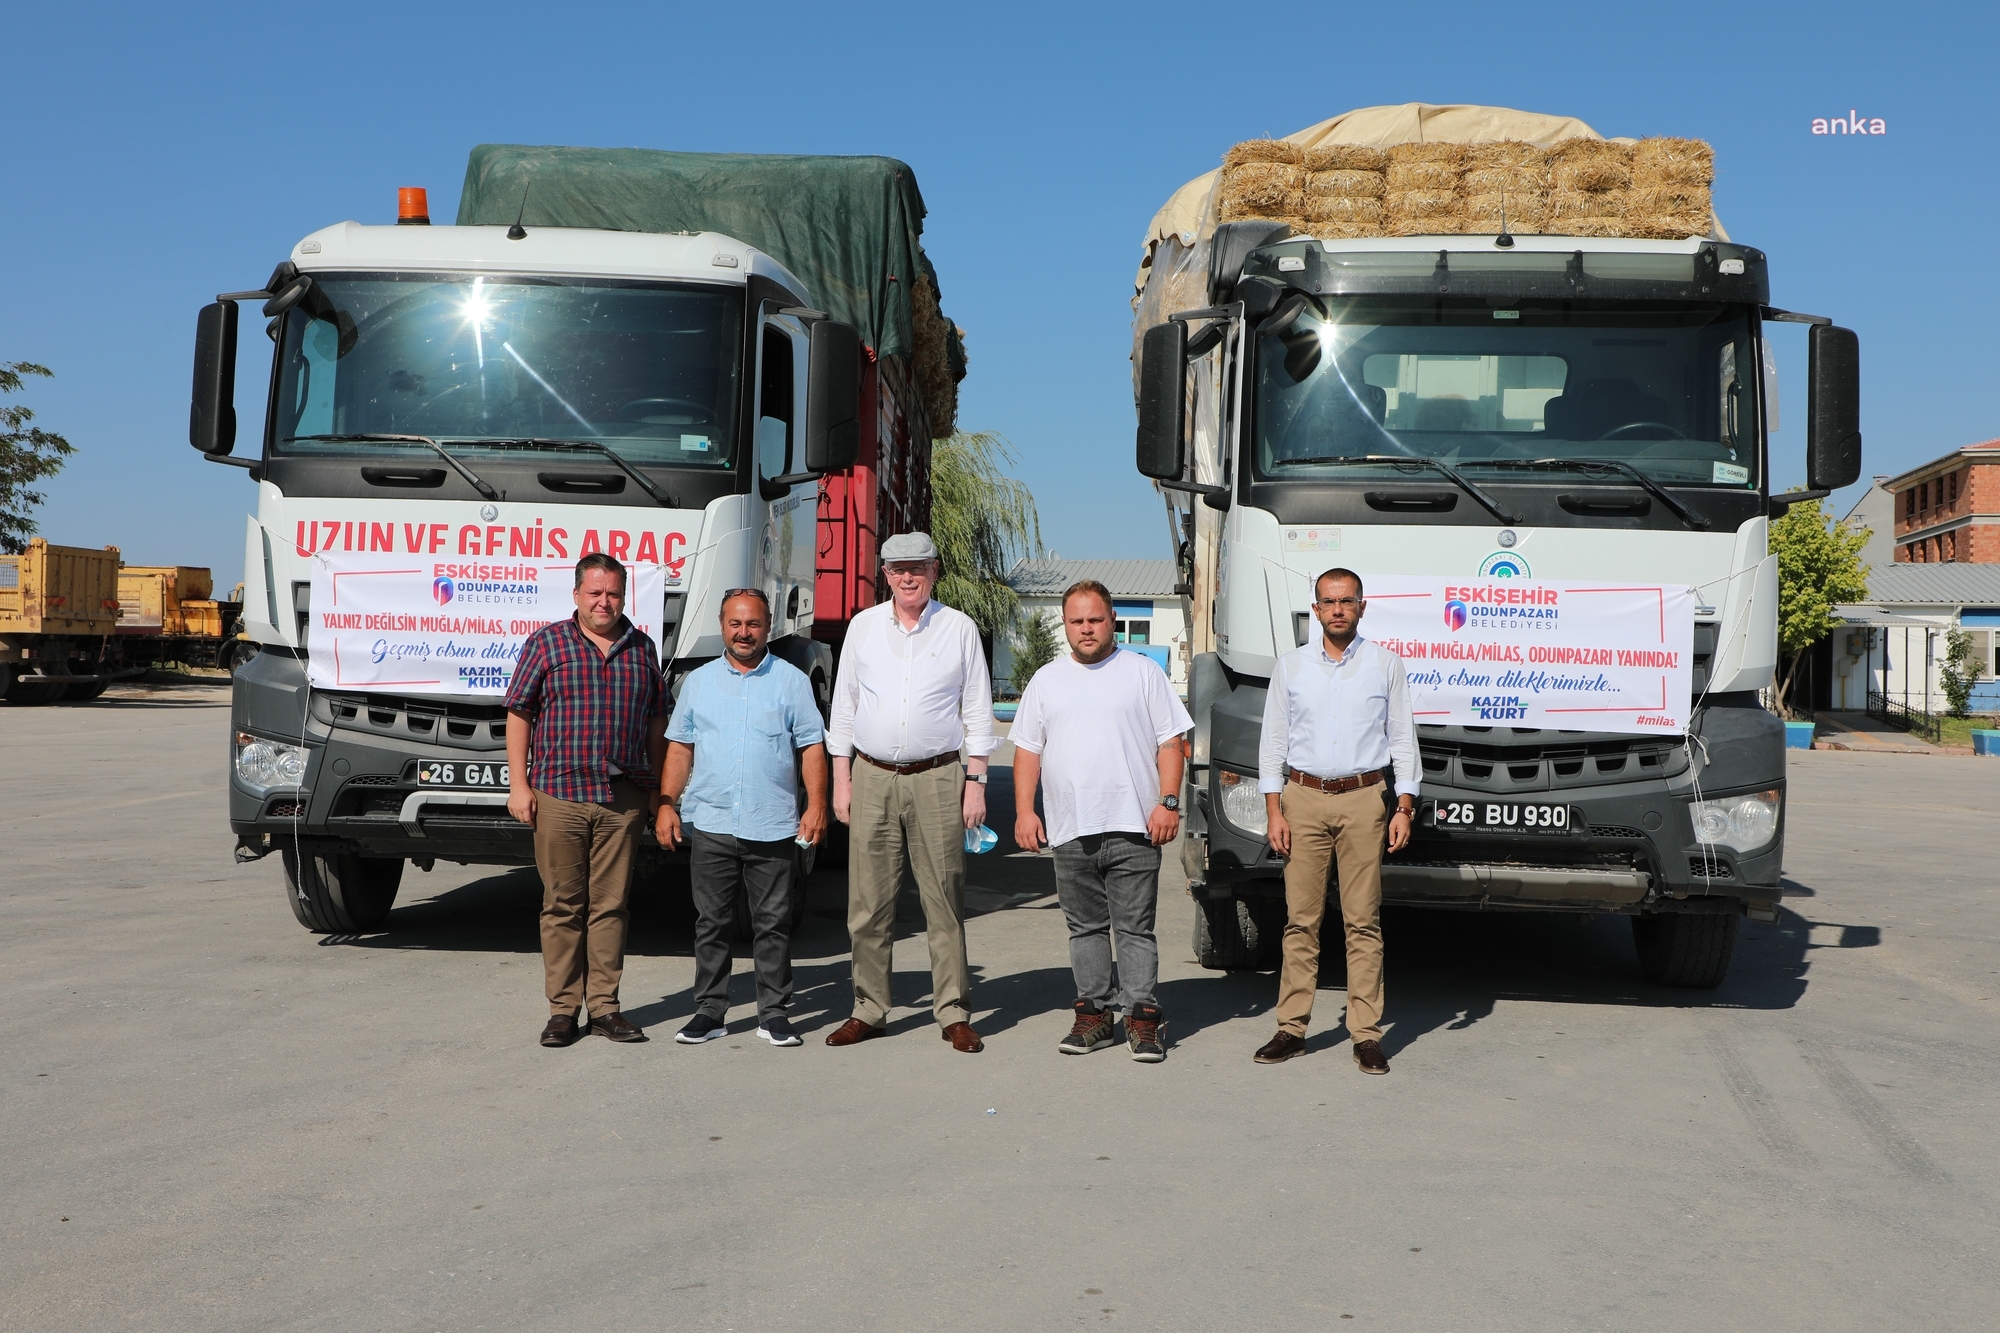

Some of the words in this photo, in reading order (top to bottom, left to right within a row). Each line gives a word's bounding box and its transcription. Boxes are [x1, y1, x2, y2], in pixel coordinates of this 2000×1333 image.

[433, 562, 538, 583] ESKİŞEHİR
[457, 582, 538, 595] ODUNPAZARI
[1445, 584, 1558, 606] ESKİŞEHİR
[1471, 606, 1558, 619] ODUNPAZARI
[323, 613, 363, 630] YALNIZ
[365, 612, 417, 632] DEĞİLSİN
[420, 614, 507, 638] MUĞLA/MİLAS,
[371, 638, 432, 664] Geçmiş
[435, 640, 477, 659] olsun
[1430, 640, 1525, 666] MUĞLA/MİLAS,
[1529, 646, 1613, 666] ODUNPAZARI
[1616, 649, 1679, 669] YANINDA!
[459, 666, 502, 676] KAZIM
[1447, 667, 1493, 687] olsun
[1496, 669, 1621, 694] dileklerimizle...
[467, 677, 512, 688] KURT
[1471, 696, 1519, 707] KAZIM
[1480, 707, 1528, 720] KURT
[1636, 714, 1676, 727] #milas
[429, 763, 455, 784] 26
[465, 764, 495, 785] GA
[1447, 803, 1475, 824] 26
[1486, 804, 1519, 826] BU
[1524, 805, 1566, 827] 930
